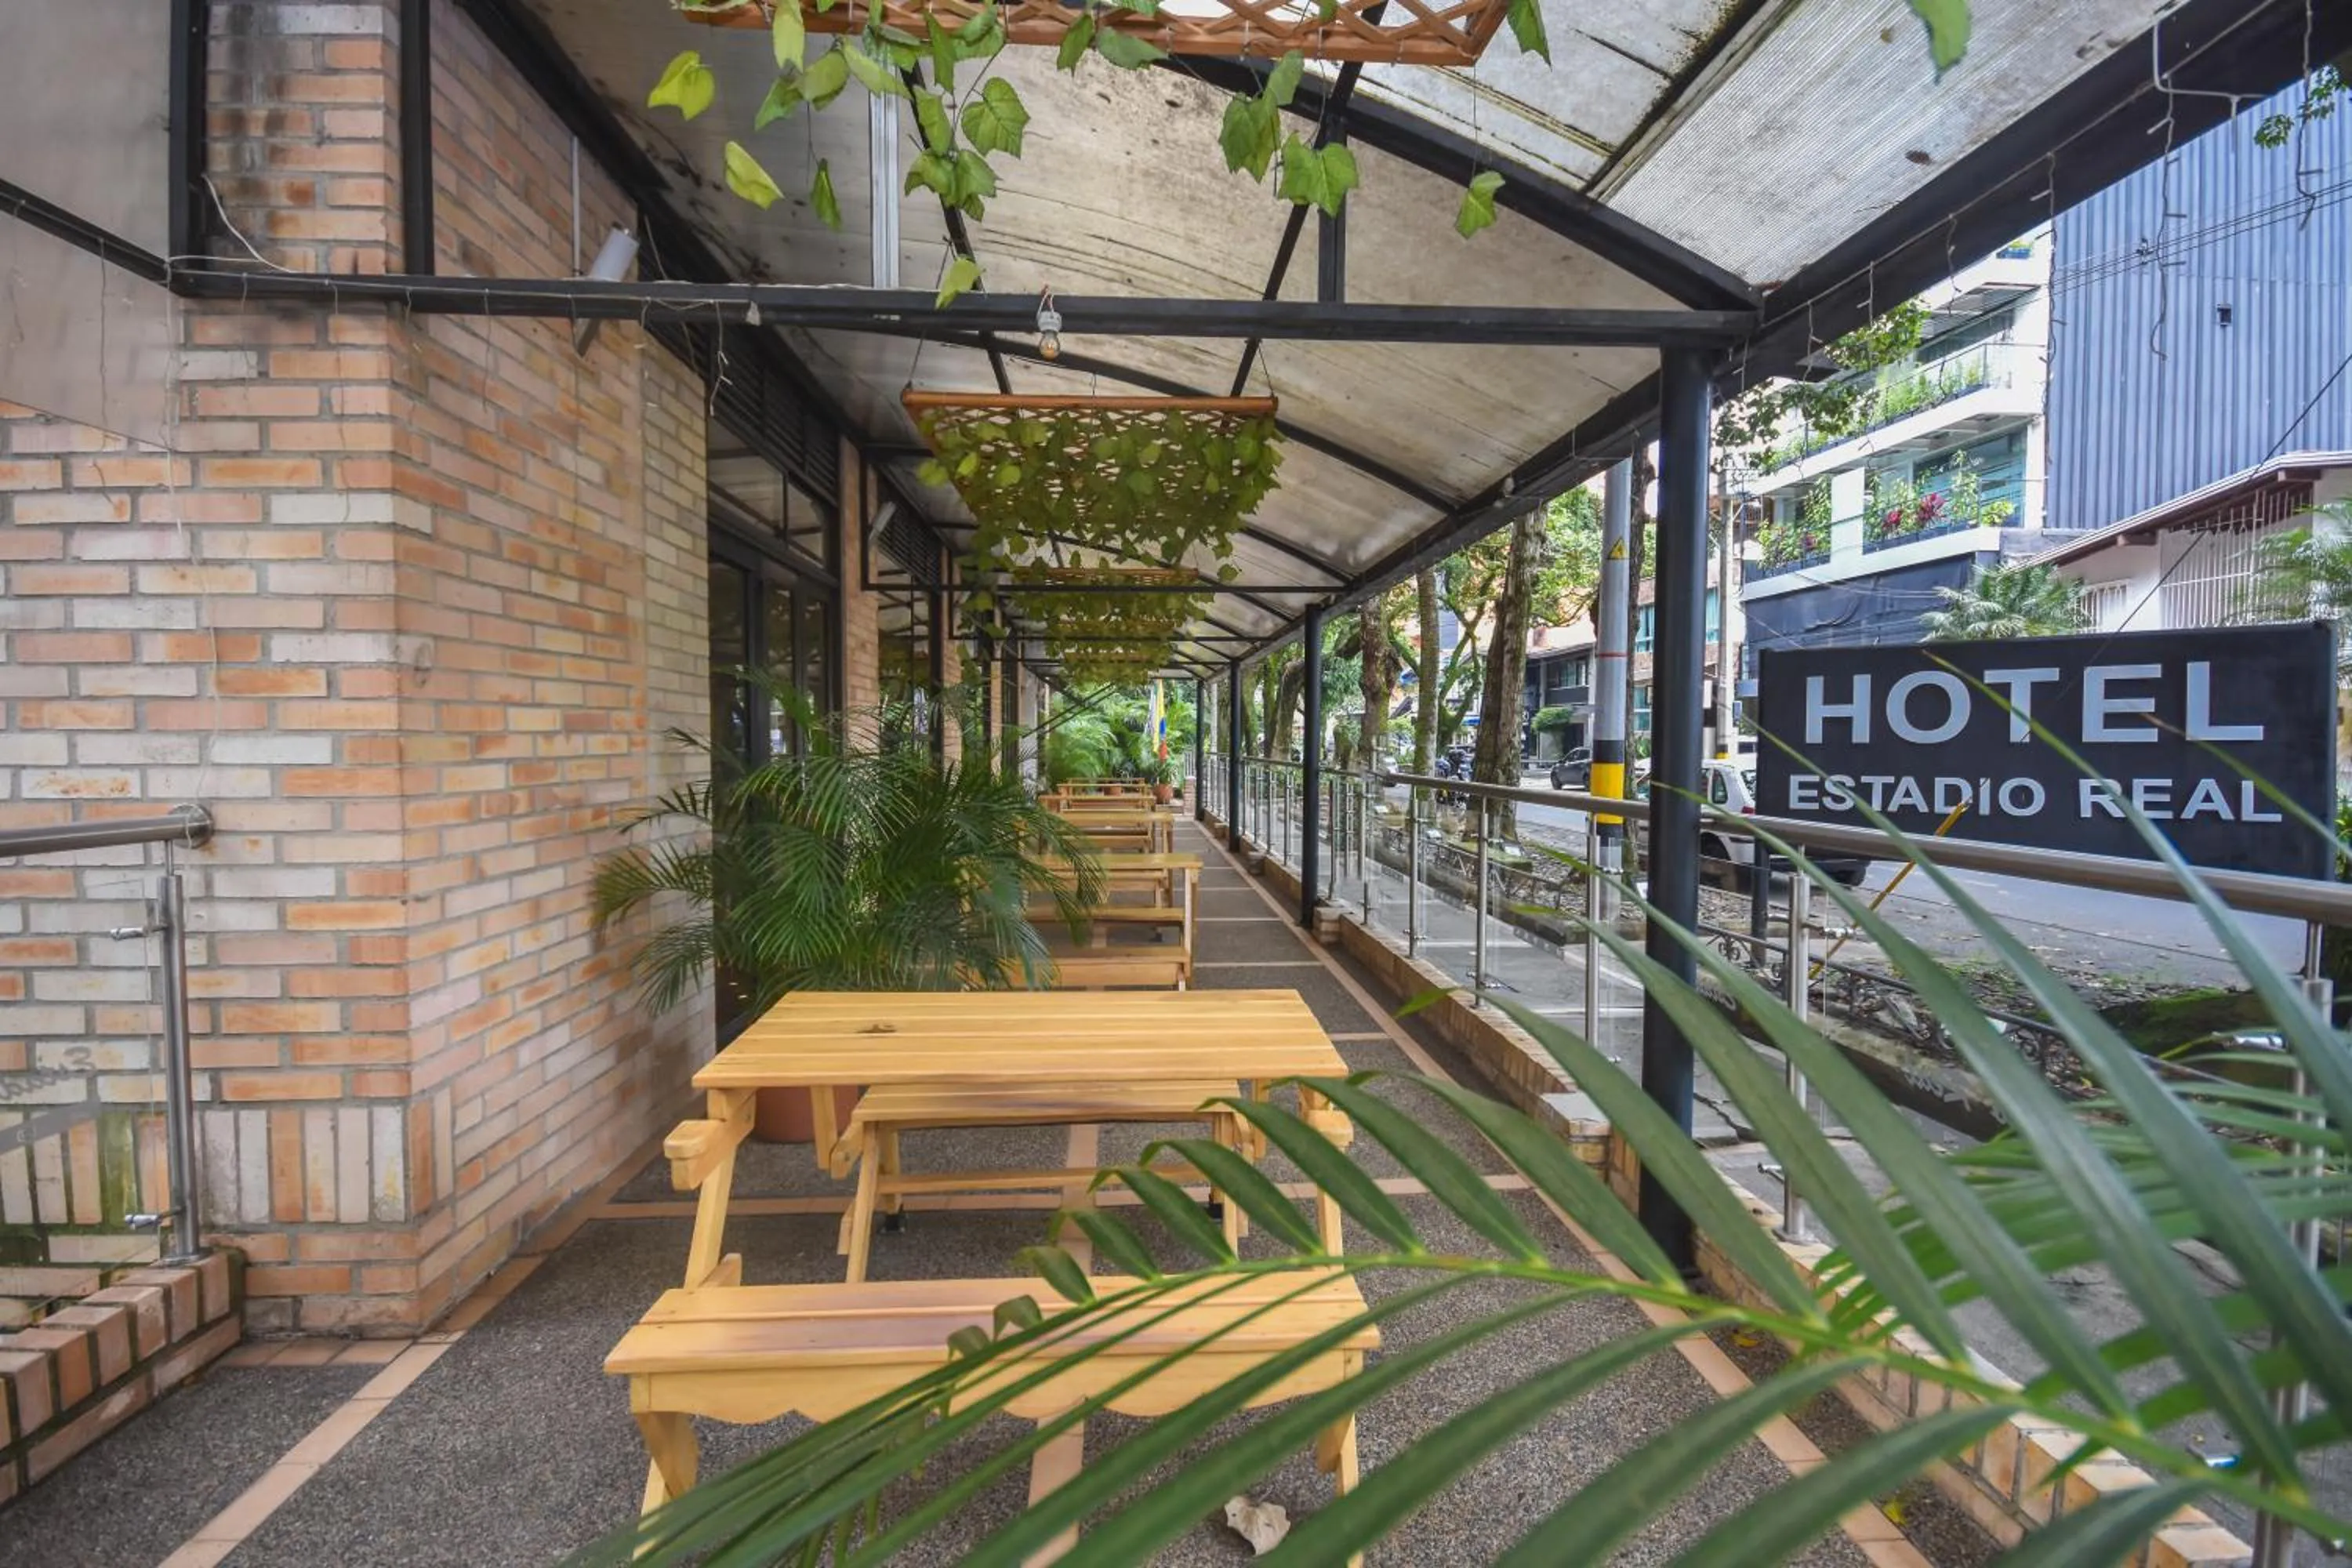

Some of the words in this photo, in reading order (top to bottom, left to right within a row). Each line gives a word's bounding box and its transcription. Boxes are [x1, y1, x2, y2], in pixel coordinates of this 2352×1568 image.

[1805, 661, 2264, 744] HOTEL
[1788, 775, 2045, 817] ESTADIO
[2078, 778, 2282, 822] REAL
